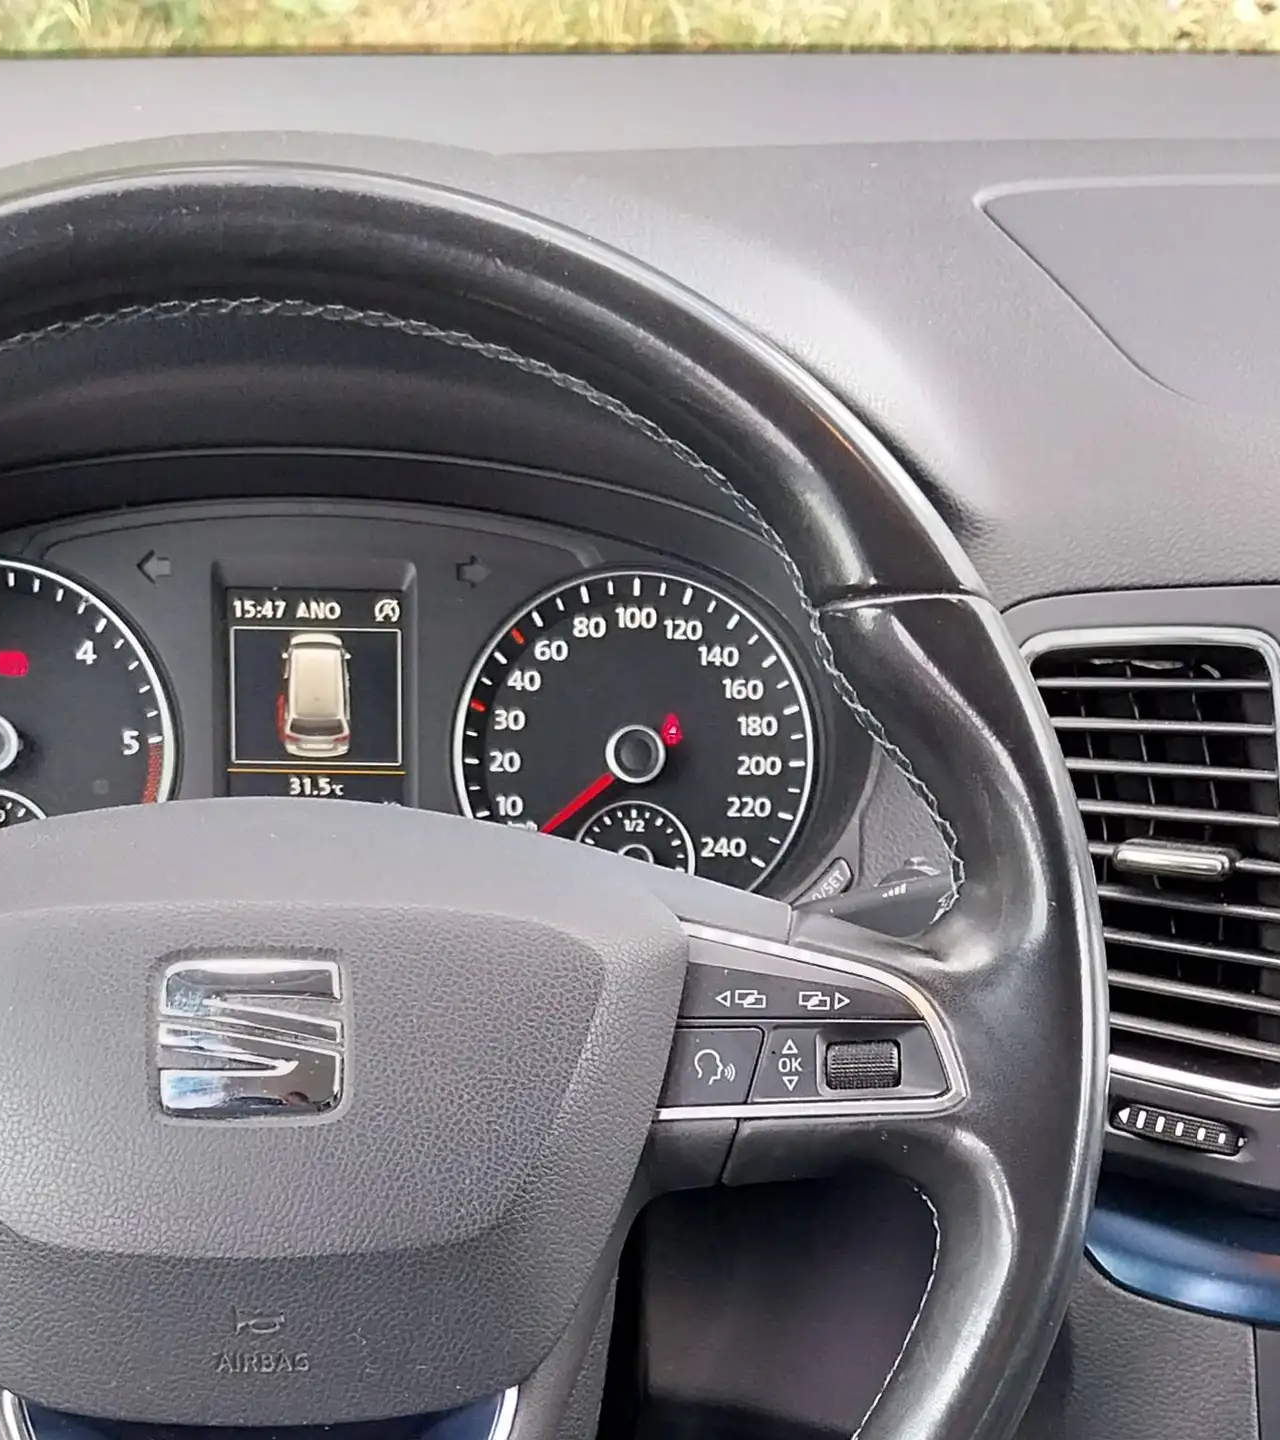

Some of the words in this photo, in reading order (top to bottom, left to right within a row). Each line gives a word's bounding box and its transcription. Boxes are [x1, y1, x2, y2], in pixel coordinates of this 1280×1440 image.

[233, 600, 287, 619] 15:47
[296, 601, 342, 619] ANO
[615, 607, 657, 629] 100
[573, 616, 607, 639] 80
[664, 619, 703, 641] 120
[76, 641, 98, 665] 4
[534, 640, 569, 662] 60
[698, 646, 740, 668] 140
[507, 671, 542, 692] 40
[723, 679, 764, 701] 160
[494, 709, 526, 732] 30
[737, 715, 778, 737] 180
[122, 731, 141, 756] 5
[489, 751, 522, 773] 20
[737, 755, 782, 776] 200
[495, 795, 524, 817] 10
[727, 797, 772, 818] 220
[623, 819, 645, 832] 1/2
[701, 837, 747, 859] 240
[778, 1057, 803, 1074] OK
[215, 1350, 310, 1374] AIRBAG
